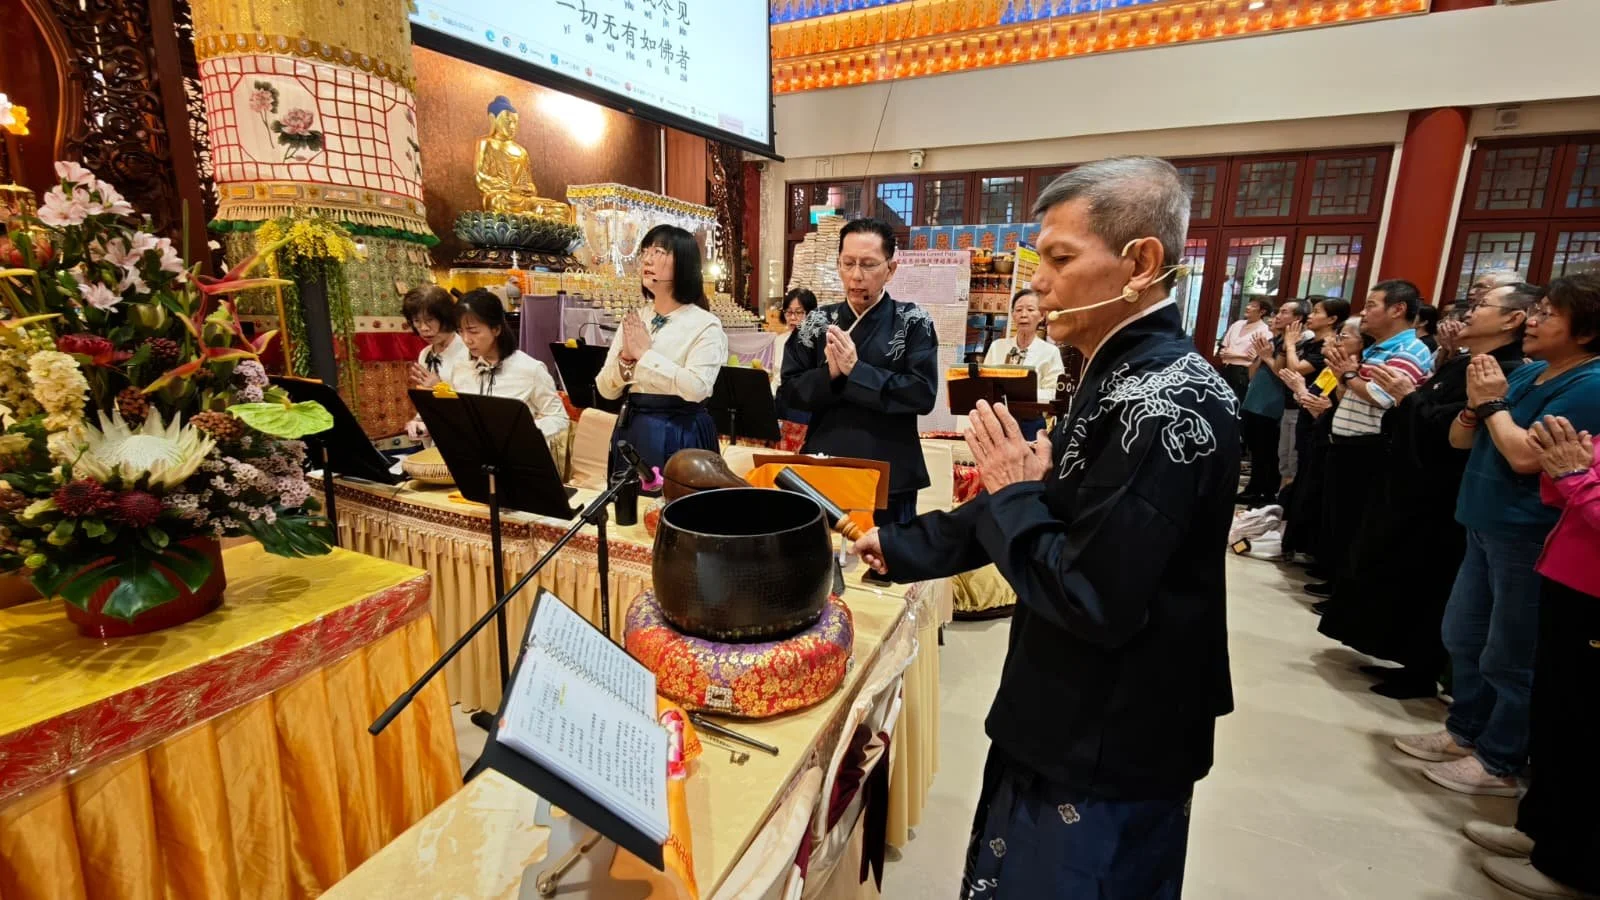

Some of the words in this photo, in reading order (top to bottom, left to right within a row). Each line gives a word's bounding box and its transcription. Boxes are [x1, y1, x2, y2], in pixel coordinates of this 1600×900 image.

[556, 0, 690, 70] 一切无有如佛者
